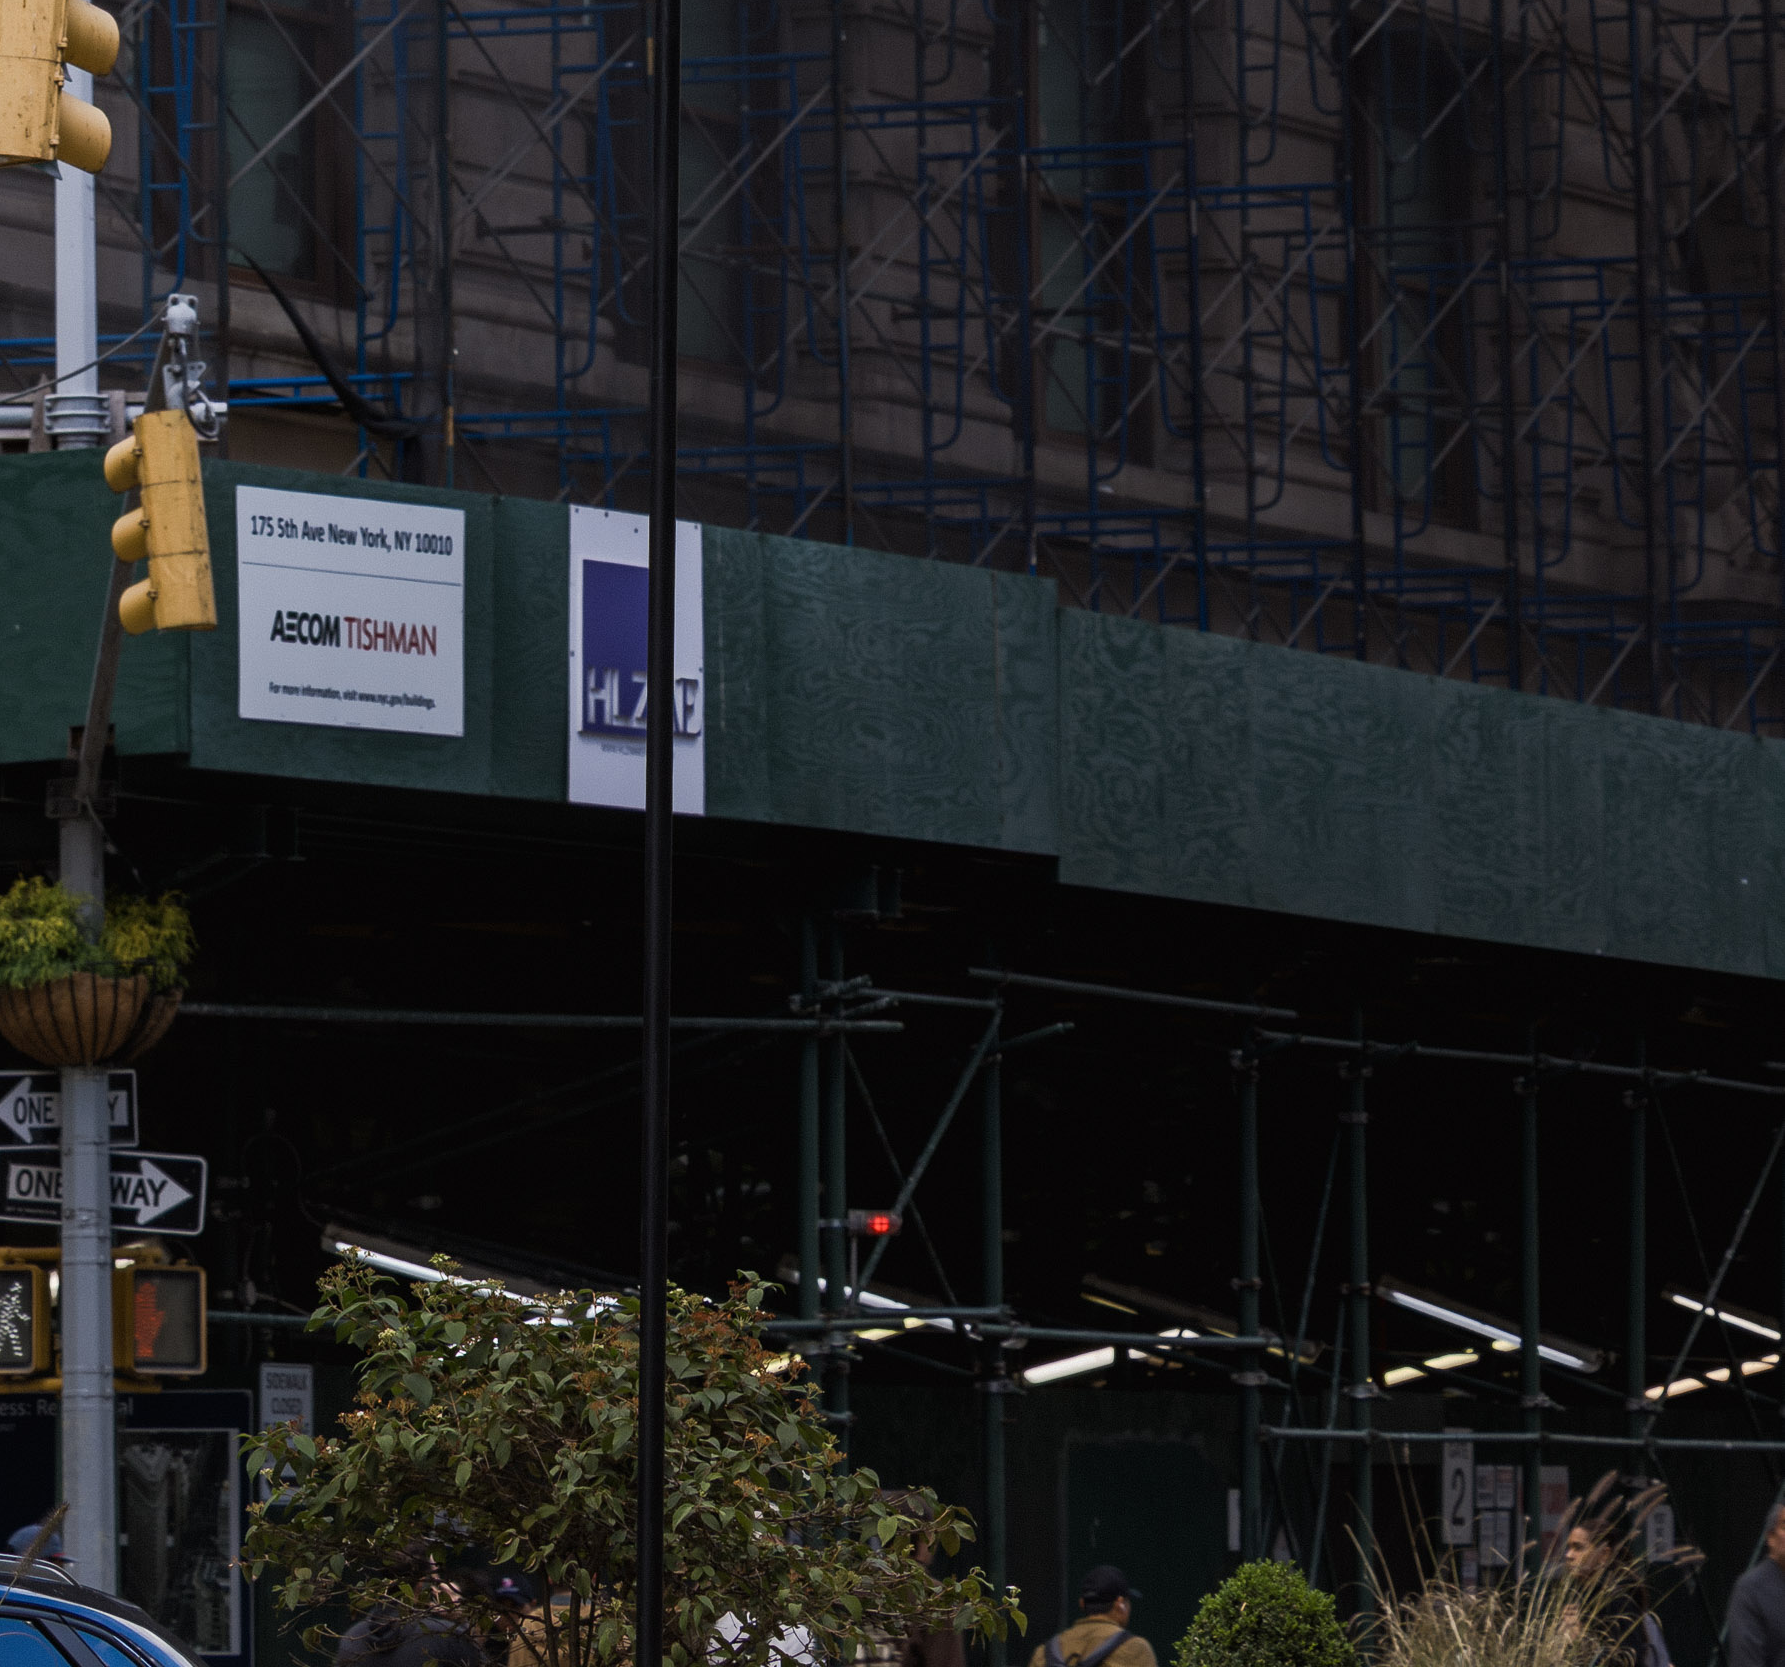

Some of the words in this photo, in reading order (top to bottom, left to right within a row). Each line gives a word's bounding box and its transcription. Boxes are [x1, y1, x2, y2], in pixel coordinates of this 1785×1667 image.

[251, 515, 274, 537] 175
[277, 517, 298, 540] 5th
[301, 521, 324, 542] Ave
[328, 523, 357, 546] New
[360, 526, 392, 553] York,
[394, 530, 412, 552] NY
[415, 533, 453, 556] 10010
[270, 610, 341, 648] AECOM
[343, 616, 437, 657] TISHMAN
[269, 681, 280, 693] For
[282, 685, 300, 696] more
[343, 689, 358, 701] visit
[14, 1097, 54, 1124] ONE
[111, 1177, 167, 1207] WAY
[1451, 1467, 1466, 1526] 2
